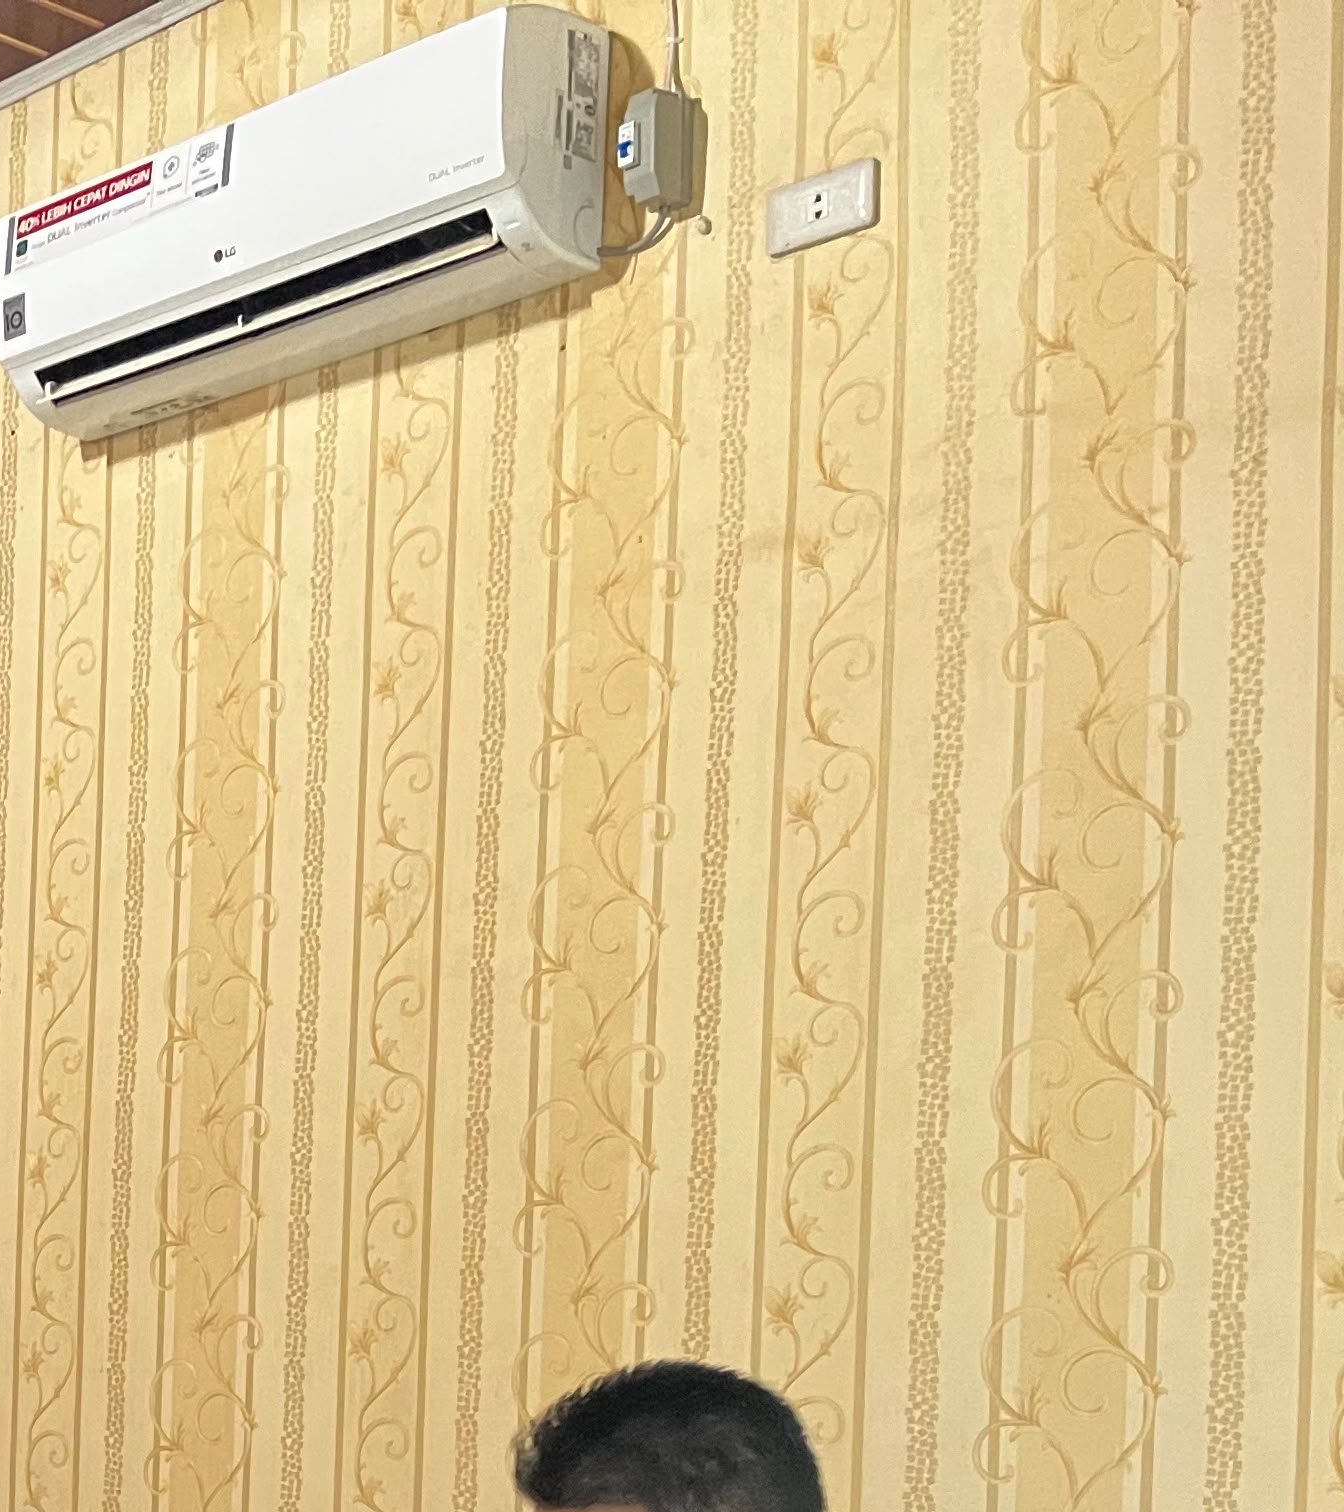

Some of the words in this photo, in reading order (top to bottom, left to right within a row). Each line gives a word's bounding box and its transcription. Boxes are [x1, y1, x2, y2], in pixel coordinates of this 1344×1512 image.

[18, 212, 41, 235] 40%
[41, 199, 73, 225] LEBIH
[73, 185, 108, 211] CEPAT
[108, 168, 151, 198] DINGIN
[224, 246, 237, 259] LG
